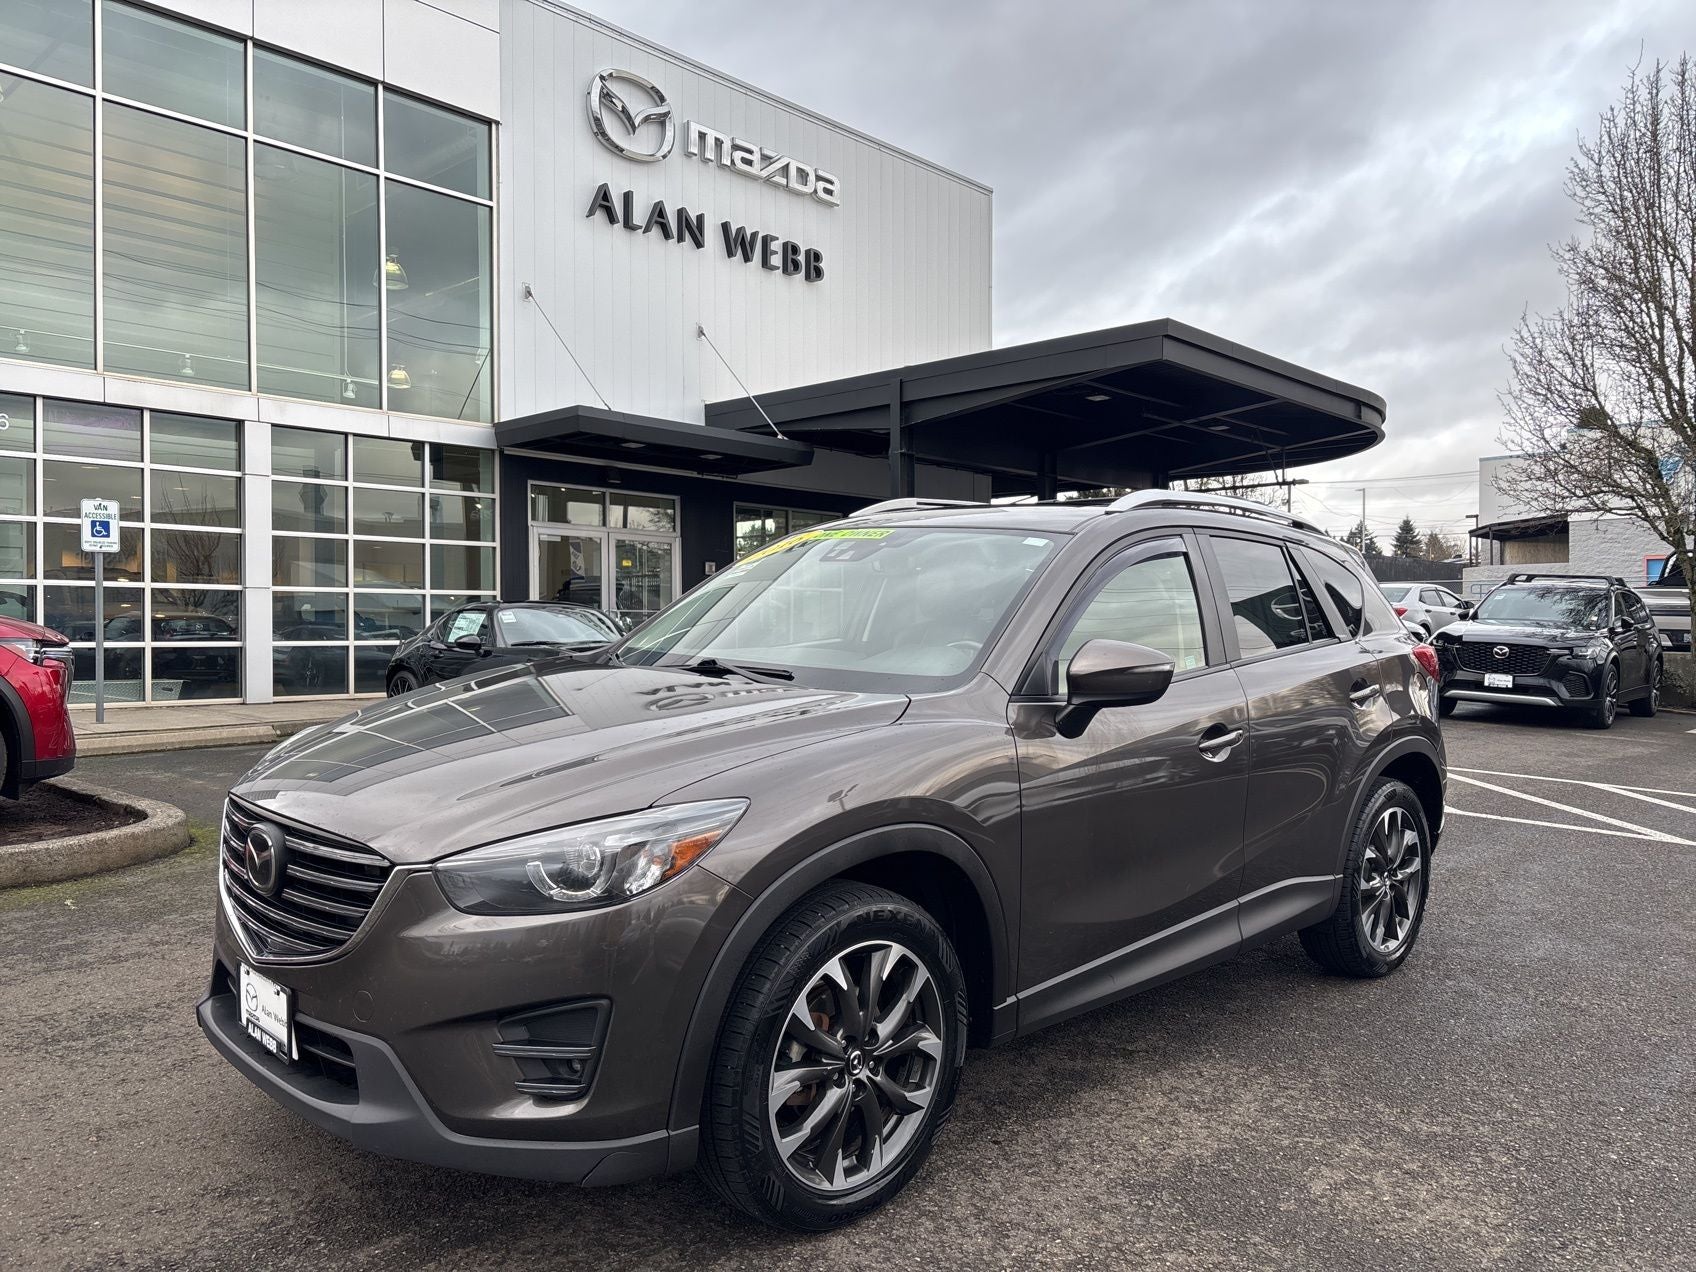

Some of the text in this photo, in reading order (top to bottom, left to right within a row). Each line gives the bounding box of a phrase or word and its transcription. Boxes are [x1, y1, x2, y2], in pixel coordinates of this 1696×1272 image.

[683, 119, 841, 208] mazda
[586, 182, 826, 283] ALAN WEBB
[84, 512, 117, 520] ACCESSIBLE
[93, 503, 108, 511] VAN
[262, 1005, 272, 1019] Alan
[248, 1022, 276, 1053] ALAN WEBB
